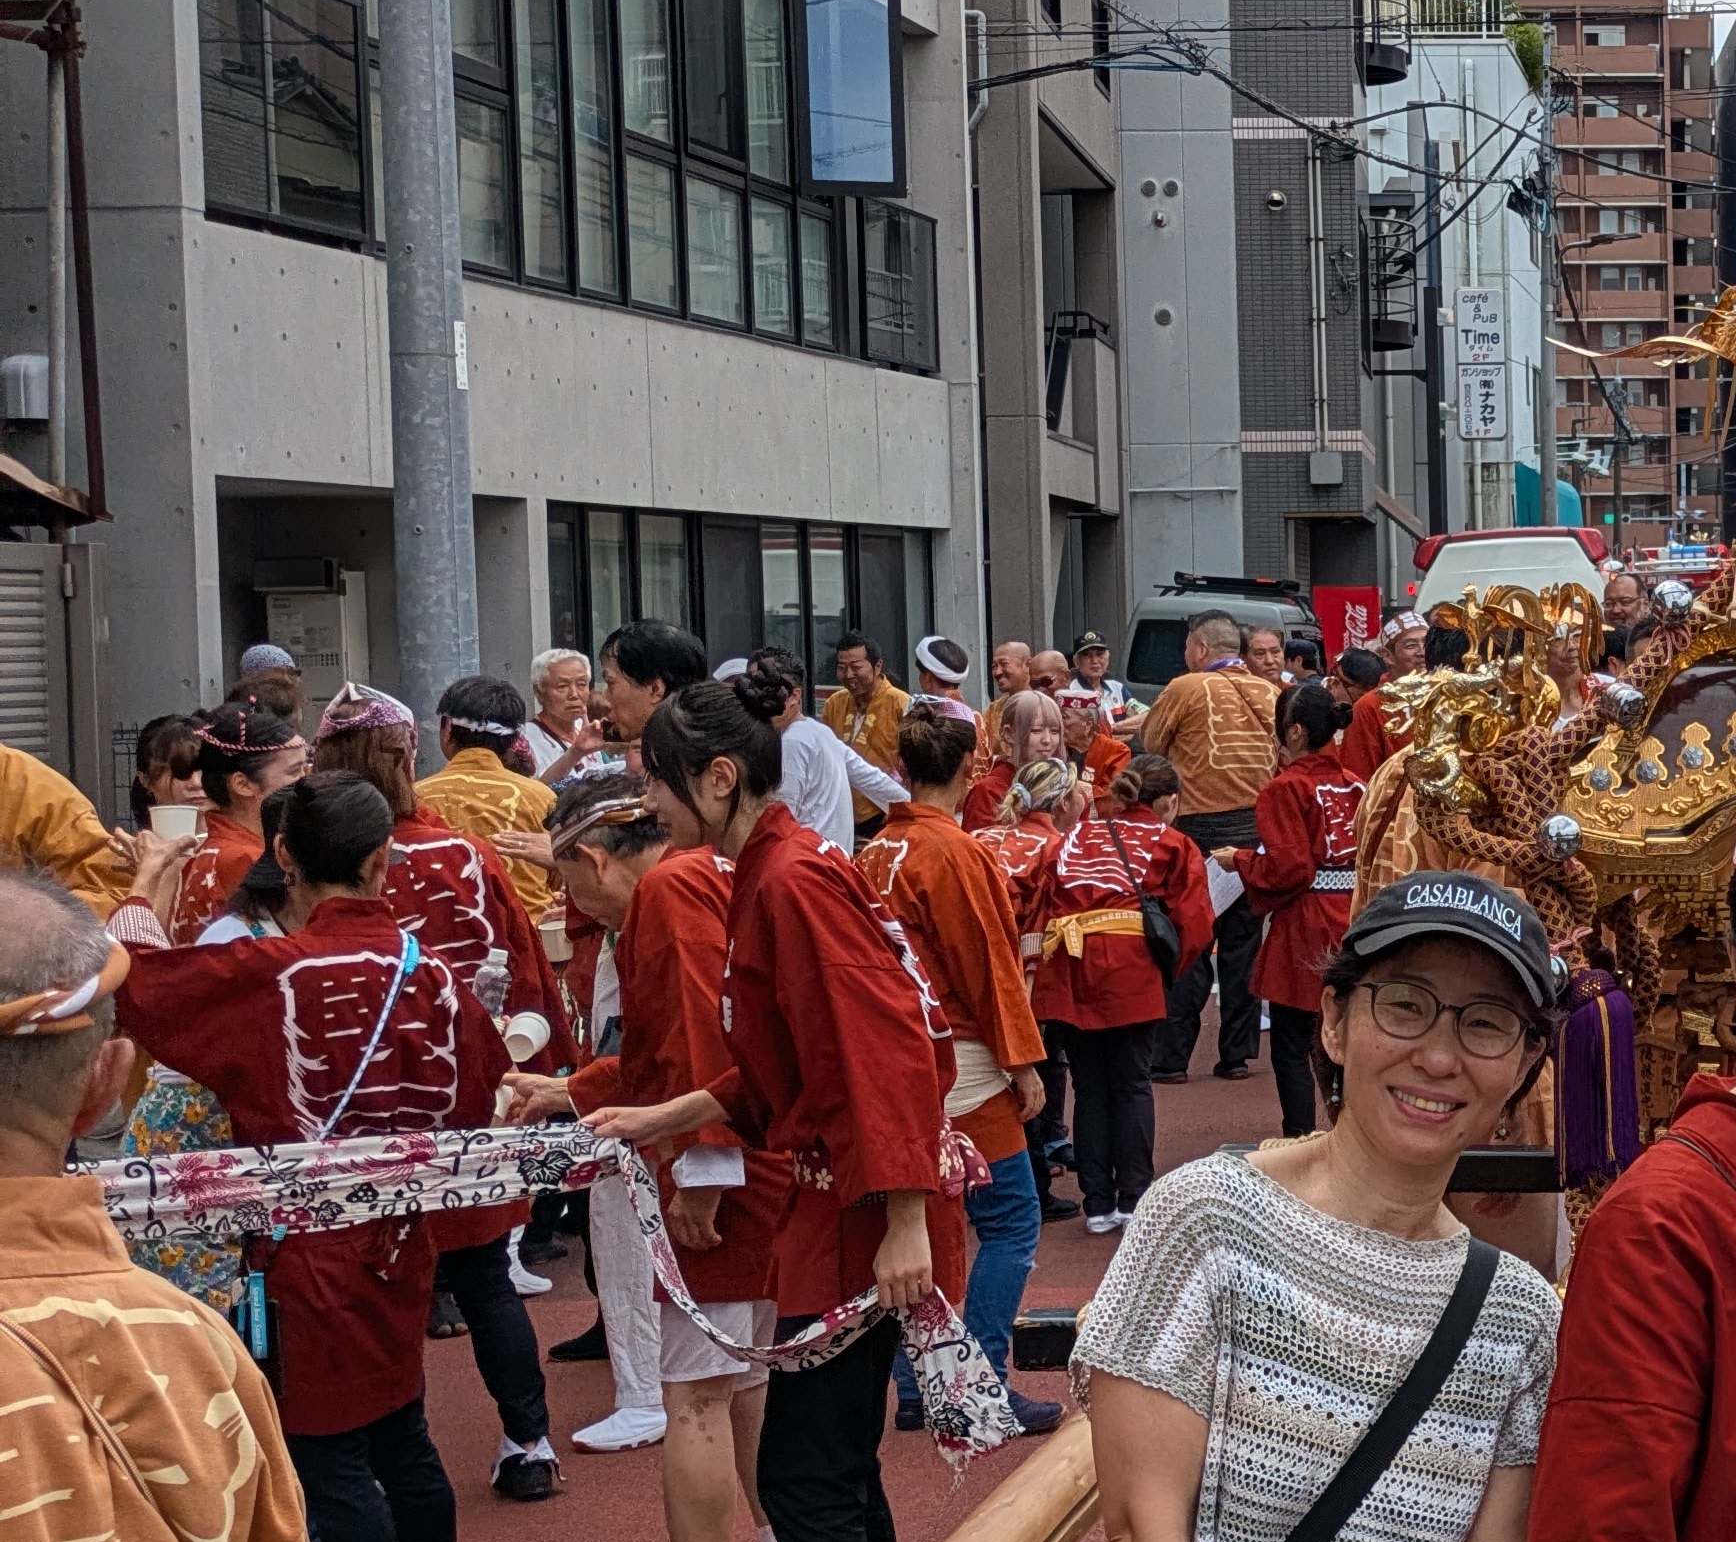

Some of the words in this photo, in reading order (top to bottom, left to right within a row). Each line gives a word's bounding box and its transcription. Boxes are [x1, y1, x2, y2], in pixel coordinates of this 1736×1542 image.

[1462, 292, 1489, 303] café
[1473, 304, 1482, 312] &
[1461, 329, 1500, 344] Time
[1406, 883, 1522, 937] CASABLANCA
